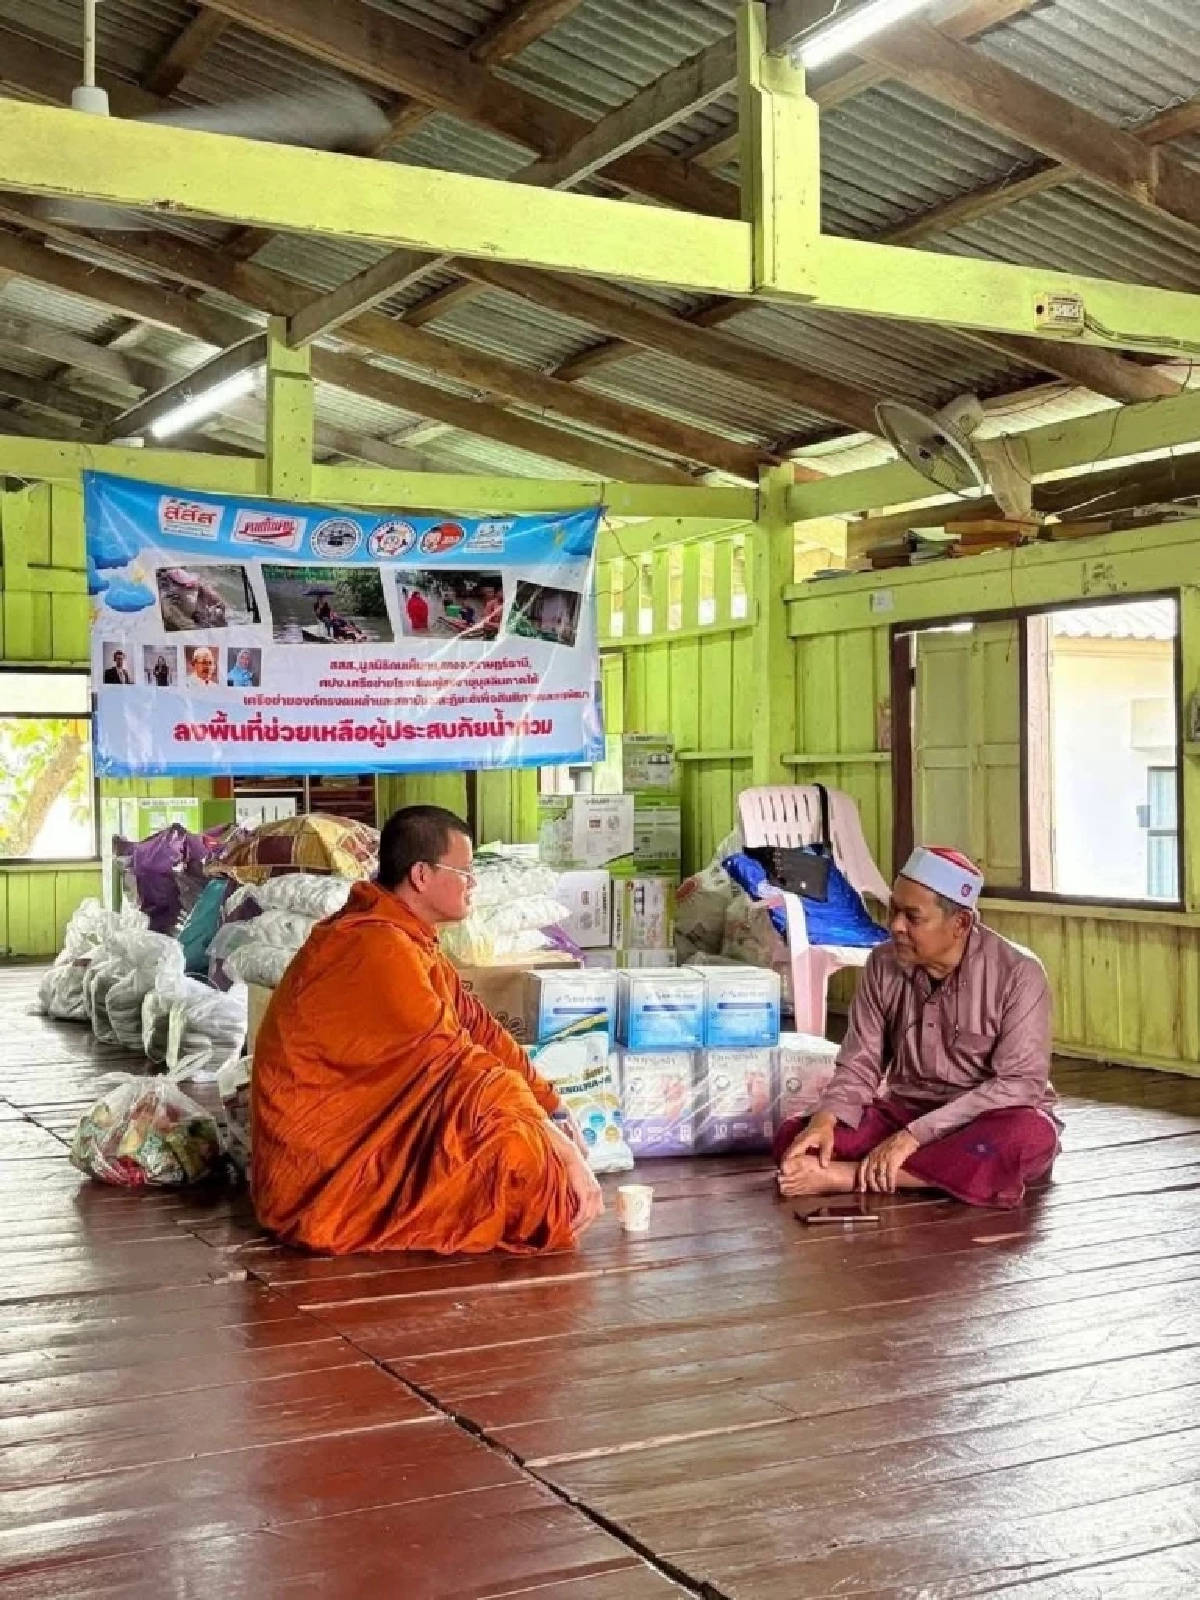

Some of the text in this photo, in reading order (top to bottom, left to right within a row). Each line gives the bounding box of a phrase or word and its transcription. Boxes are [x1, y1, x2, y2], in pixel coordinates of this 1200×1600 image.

[174, 708, 553, 748] ลงพื้นที่ช่วยเหลือผู้ประสบภัยน้ำท่วม
